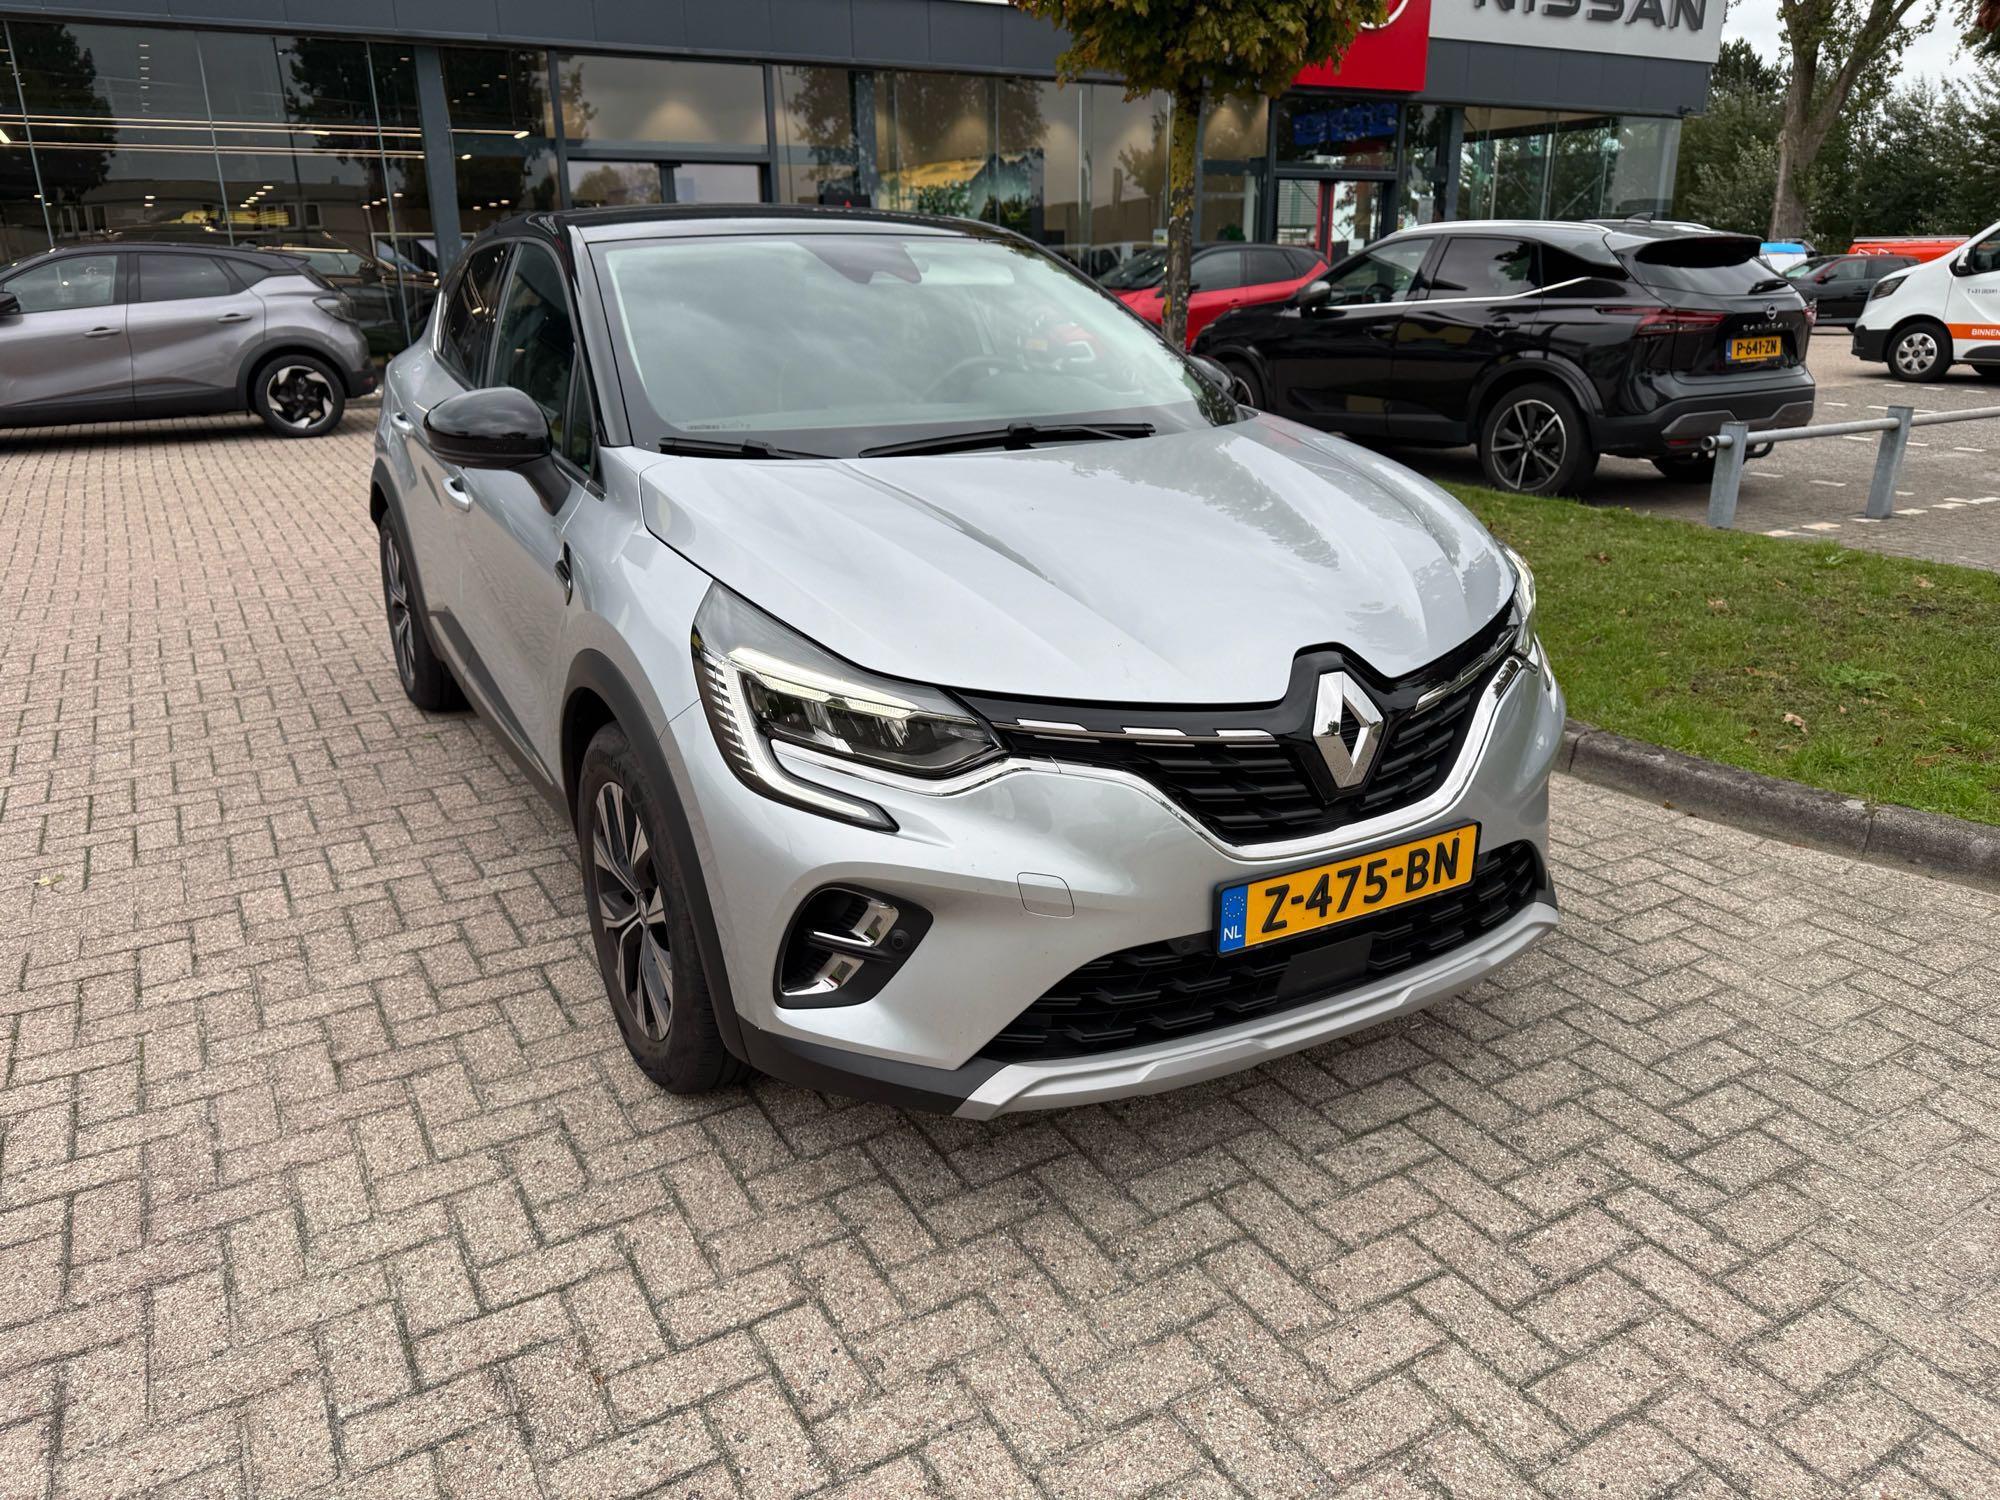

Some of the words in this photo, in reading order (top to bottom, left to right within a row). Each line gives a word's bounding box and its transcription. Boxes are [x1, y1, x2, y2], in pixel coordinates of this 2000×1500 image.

[1474, 0, 1705, 31] SAN
[1736, 340, 1777, 356] P-641-ZN
[1261, 838, 1460, 934] Z-475-BN
[1223, 925, 1242, 942] NL
